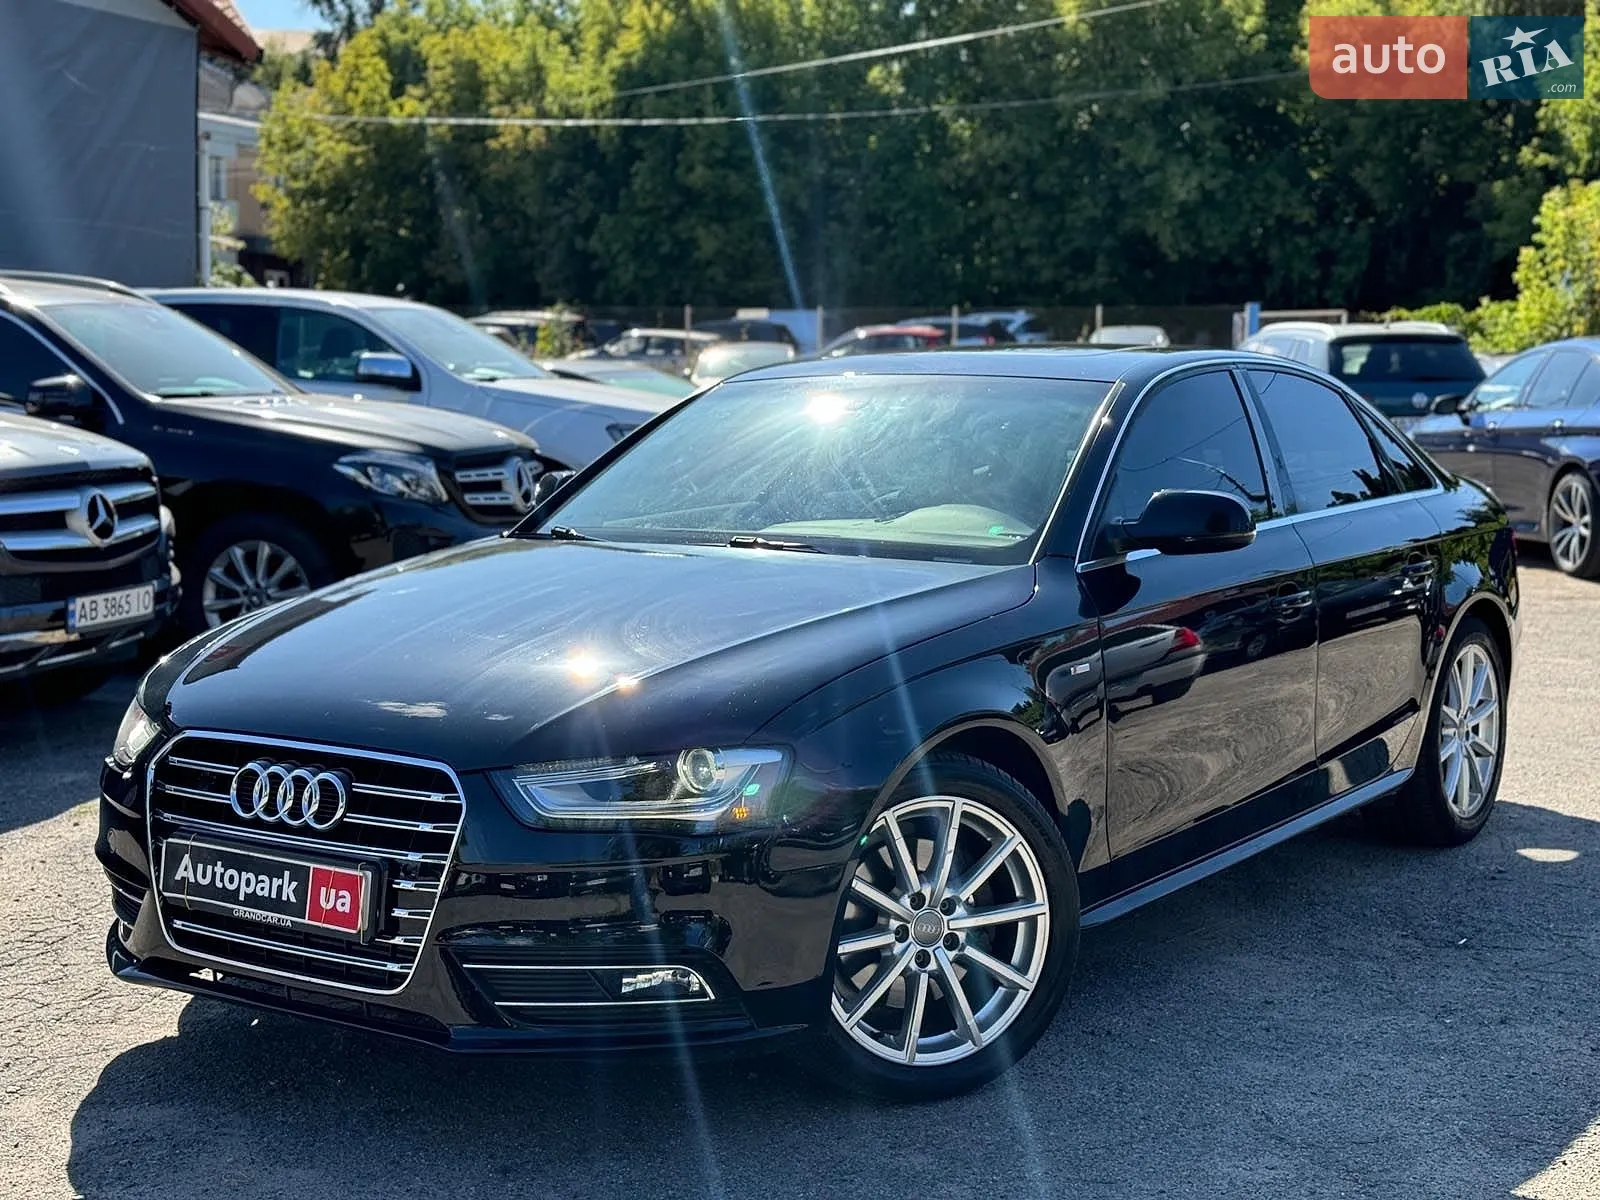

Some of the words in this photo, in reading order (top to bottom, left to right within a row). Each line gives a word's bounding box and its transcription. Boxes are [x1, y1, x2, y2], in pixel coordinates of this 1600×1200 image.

[78, 600, 98, 623] AB
[103, 593, 131, 618] 3865
[174, 853, 297, 903] Autopark
[319, 886, 351, 914] ua
[233, 908, 293, 929] GRANDCAR.UA
